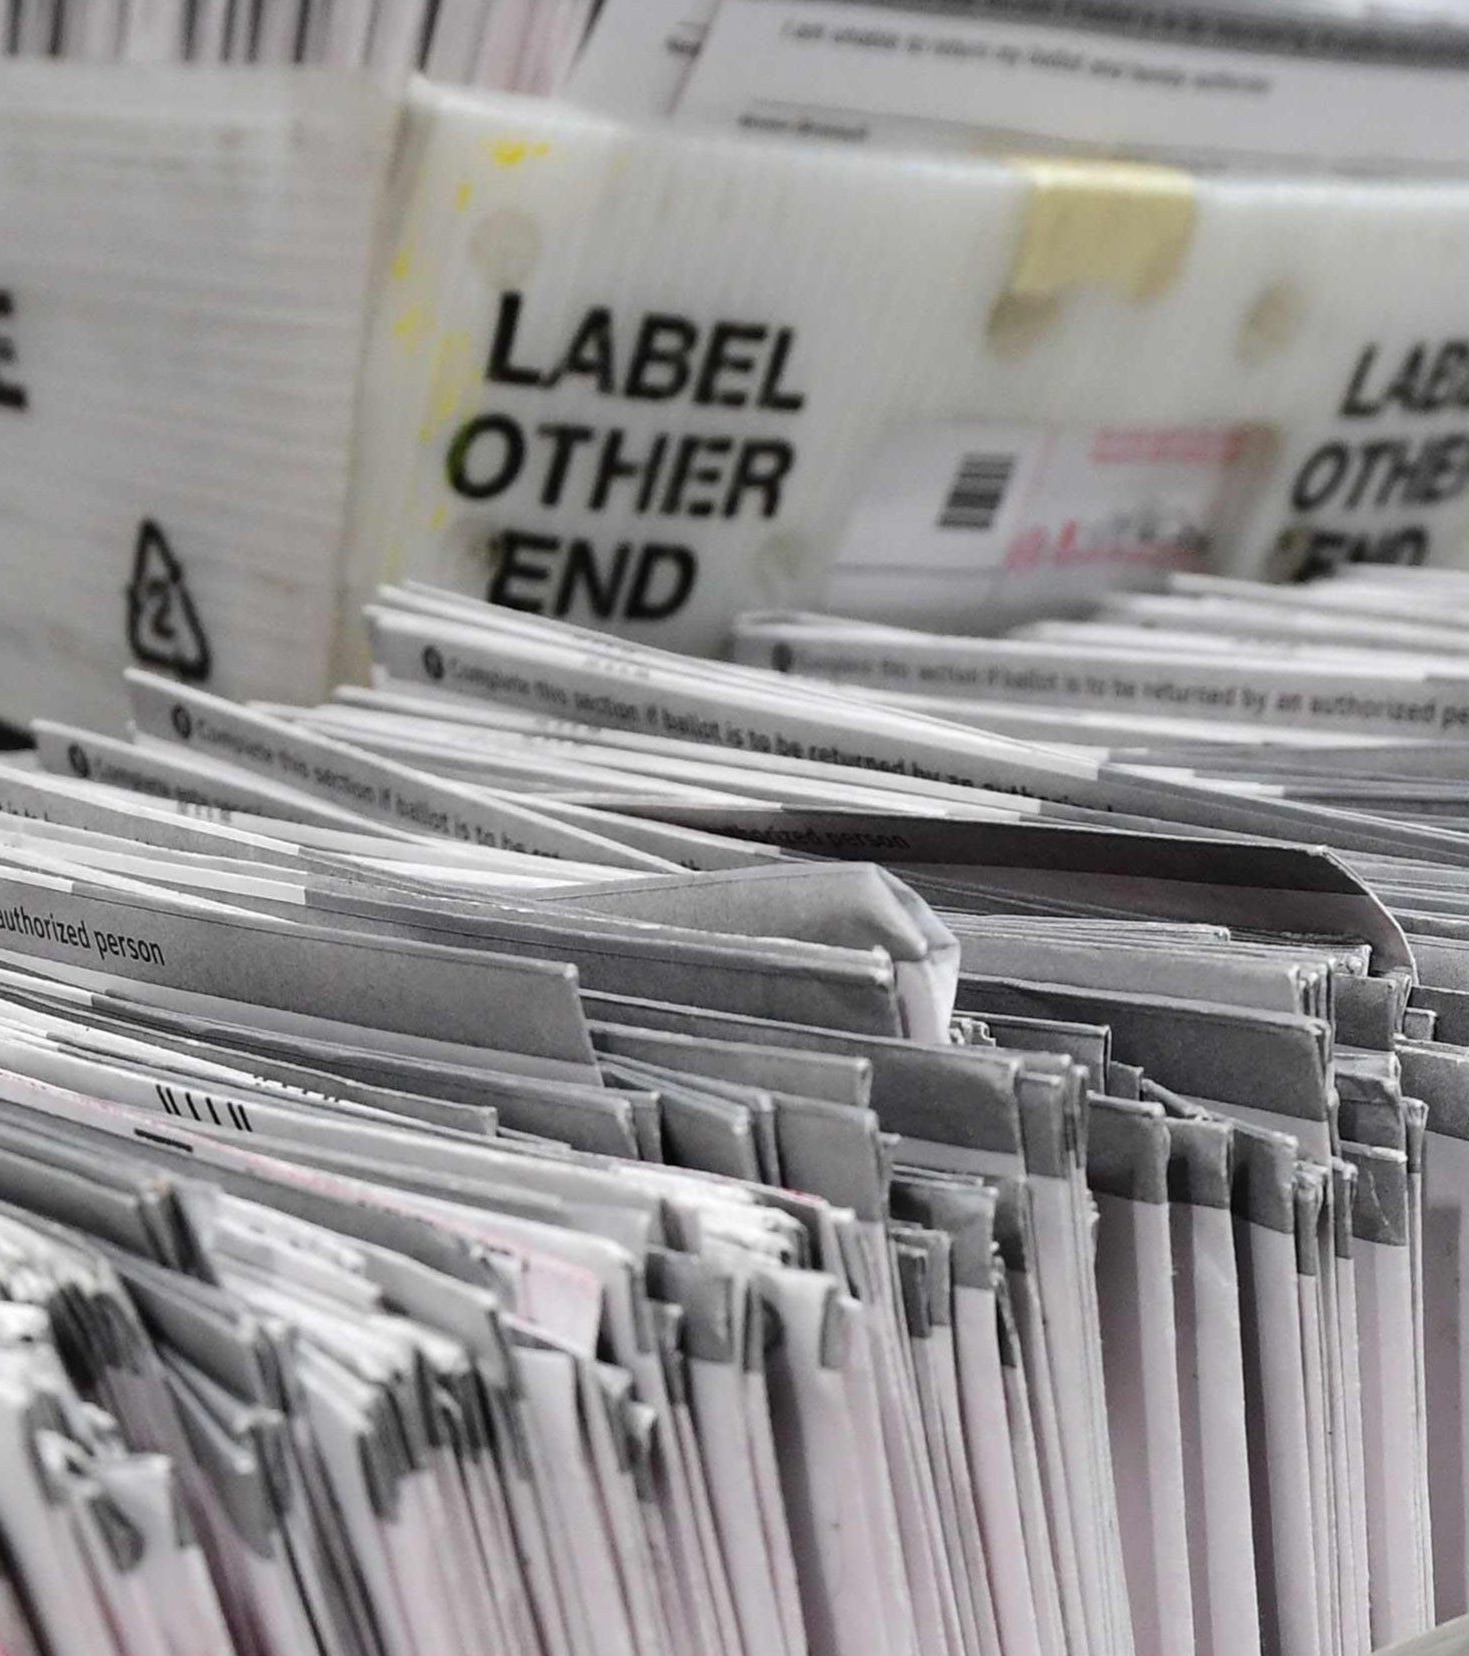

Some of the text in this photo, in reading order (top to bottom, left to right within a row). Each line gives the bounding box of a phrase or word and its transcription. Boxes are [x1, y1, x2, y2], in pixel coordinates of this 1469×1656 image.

[486, 291, 806, 414] LABEL
[446, 413, 796, 520] OTHER
[485, 529, 699, 622] END
[1309, 692, 1436, 723] authorized
[825, 828, 912, 852] person
[94, 929, 167, 967] person
